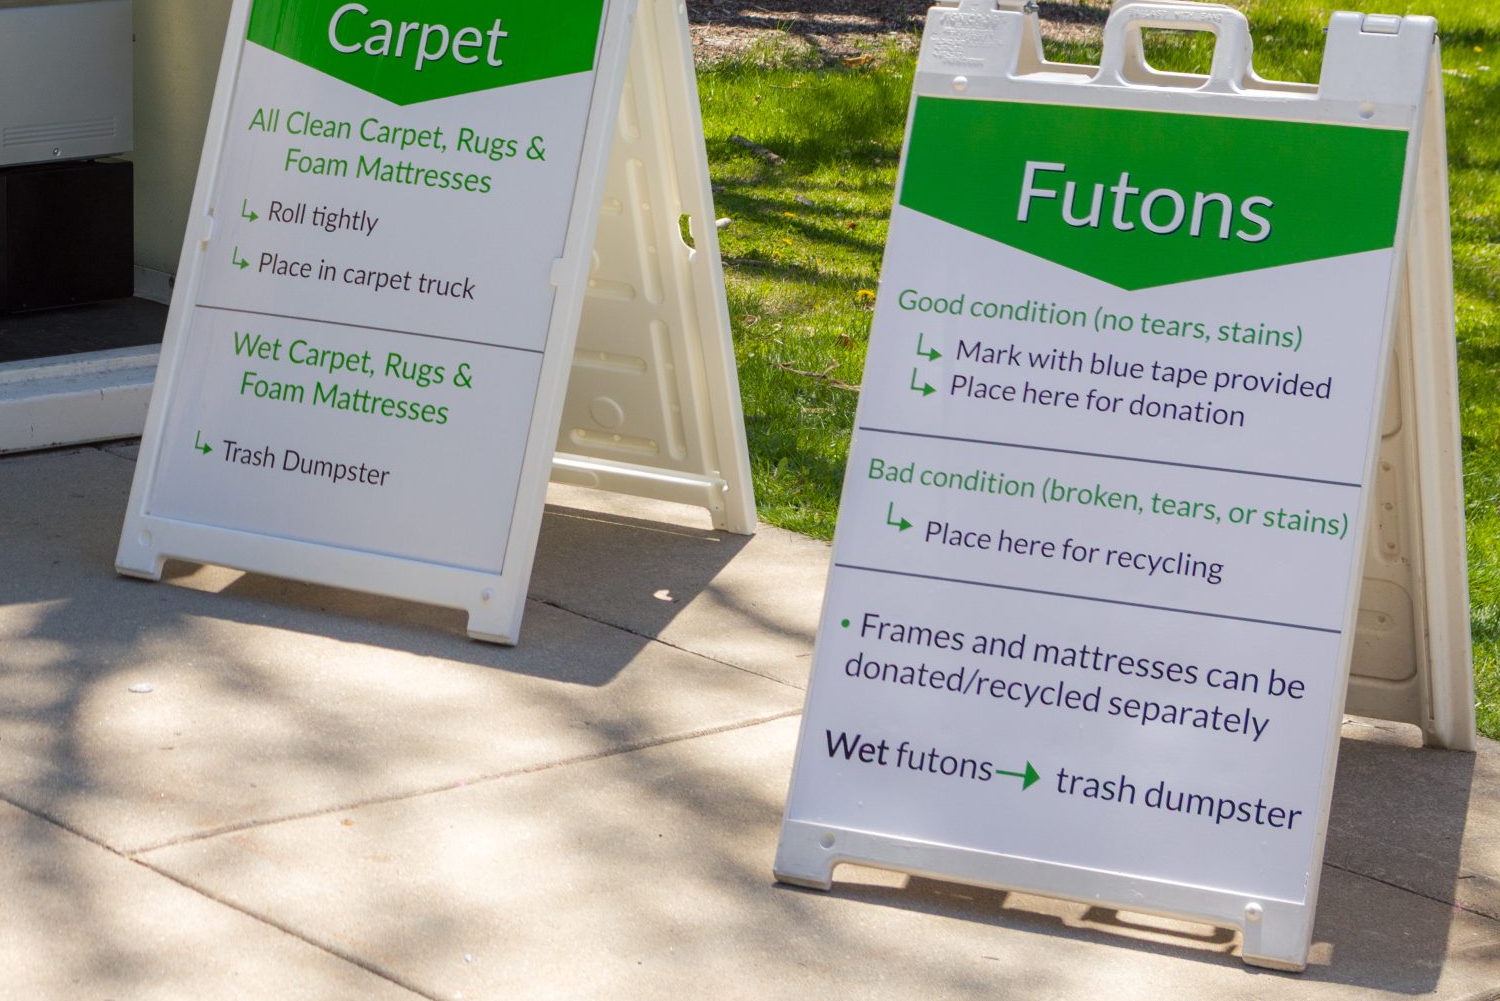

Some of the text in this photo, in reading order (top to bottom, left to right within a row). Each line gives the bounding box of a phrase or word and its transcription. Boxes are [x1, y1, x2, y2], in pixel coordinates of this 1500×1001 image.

[328, 2, 508, 70] Carpet
[248, 108, 545, 161] All Clean Carpet, Rugs &
[285, 148, 491, 193] Foam Mattresses
[269, 201, 379, 237] Roll tightly
[1016, 160, 1274, 243] Futons
[259, 252, 475, 300] Place in carpet truck
[899, 289, 1302, 352] Good condition (no tears, stains)
[235, 332, 472, 388] Wet Carpet, Rugs &
[956, 340, 1332, 399] Mark with blue tape provided
[241, 371, 448, 424] Foam Mattresses
[951, 374, 1244, 427] Place here for donation
[223, 440, 390, 486] Trash Dumpster
[869, 458, 1347, 540] Bad condition (broken, tears, or stains)
[925, 521, 1224, 584] Place here for recycling
[861, 613, 1305, 699] Frames and mattresses can be
[844, 651, 1270, 742] donated/recycled separately
[826, 729, 1302, 830] Wet futons trash dumpster
